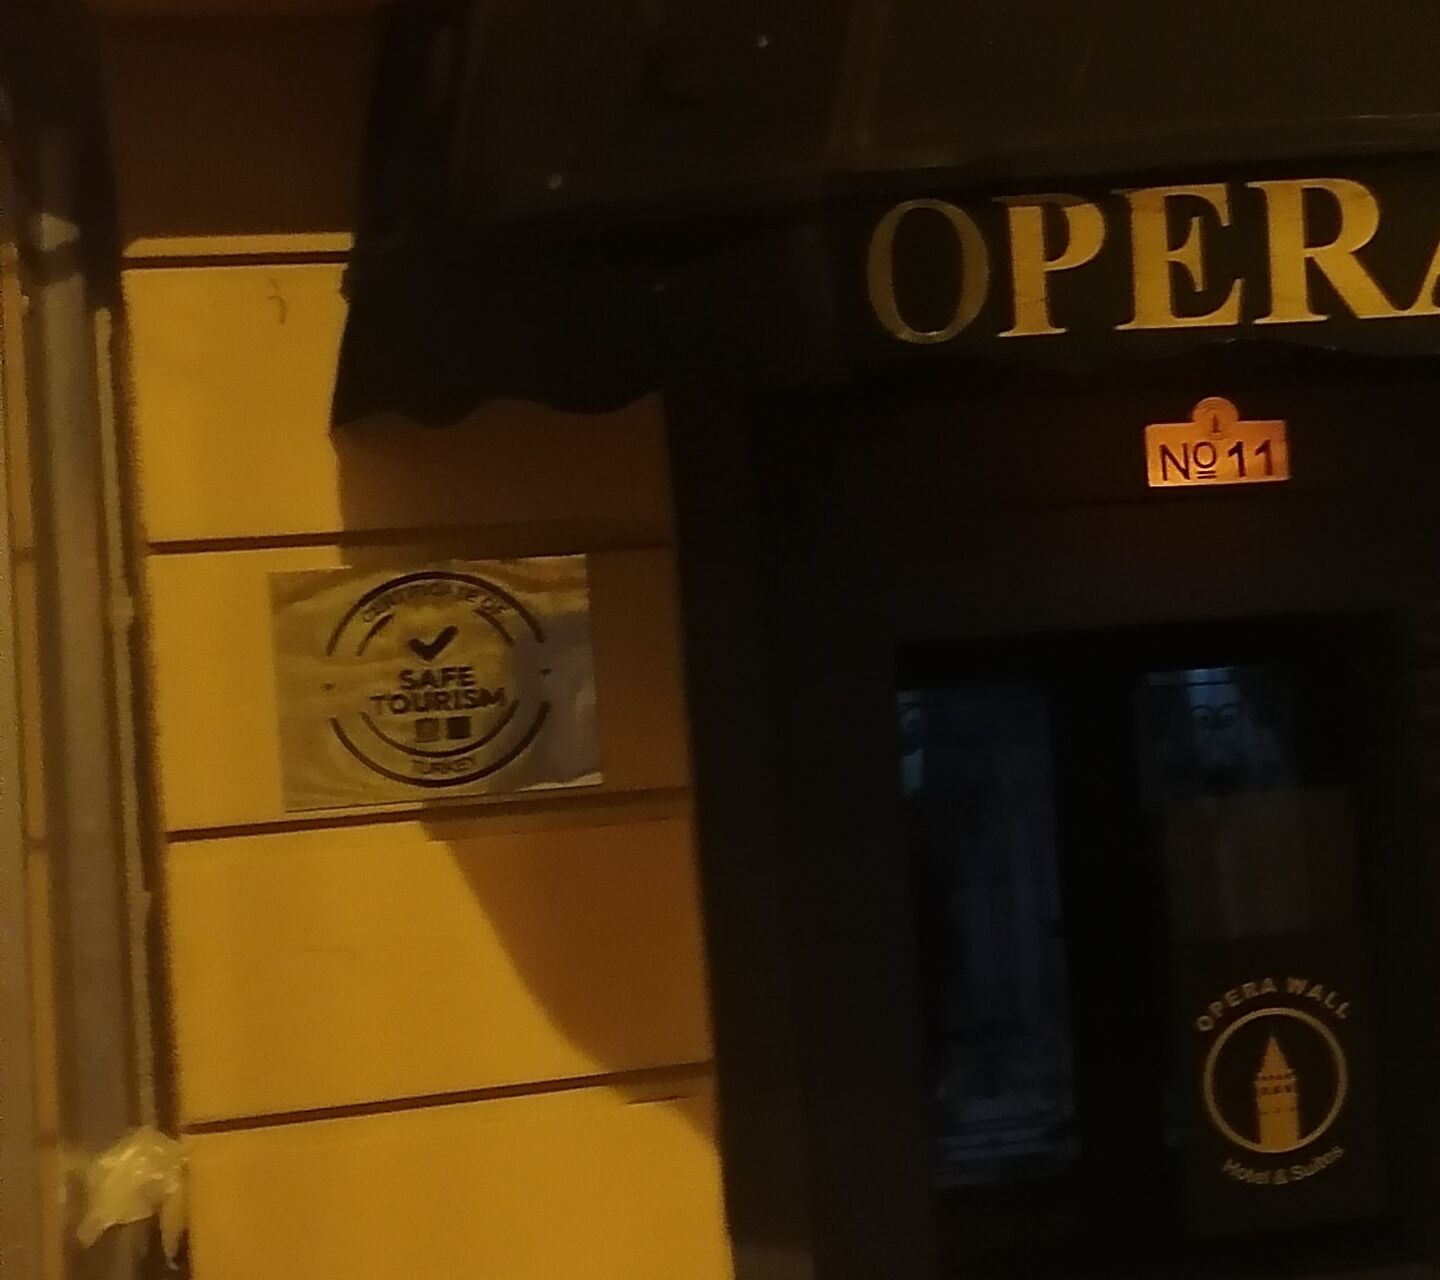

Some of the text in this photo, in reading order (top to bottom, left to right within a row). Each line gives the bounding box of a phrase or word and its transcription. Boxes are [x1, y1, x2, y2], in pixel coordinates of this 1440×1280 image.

[399, 665, 475, 692] SAFE
[369, 686, 507, 715] TOURISM
[1196, 976, 1351, 1032] OPERA WALL
[1222, 1158, 1270, 1185] Hotel
[1290, 1146, 1345, 1182] Suites
